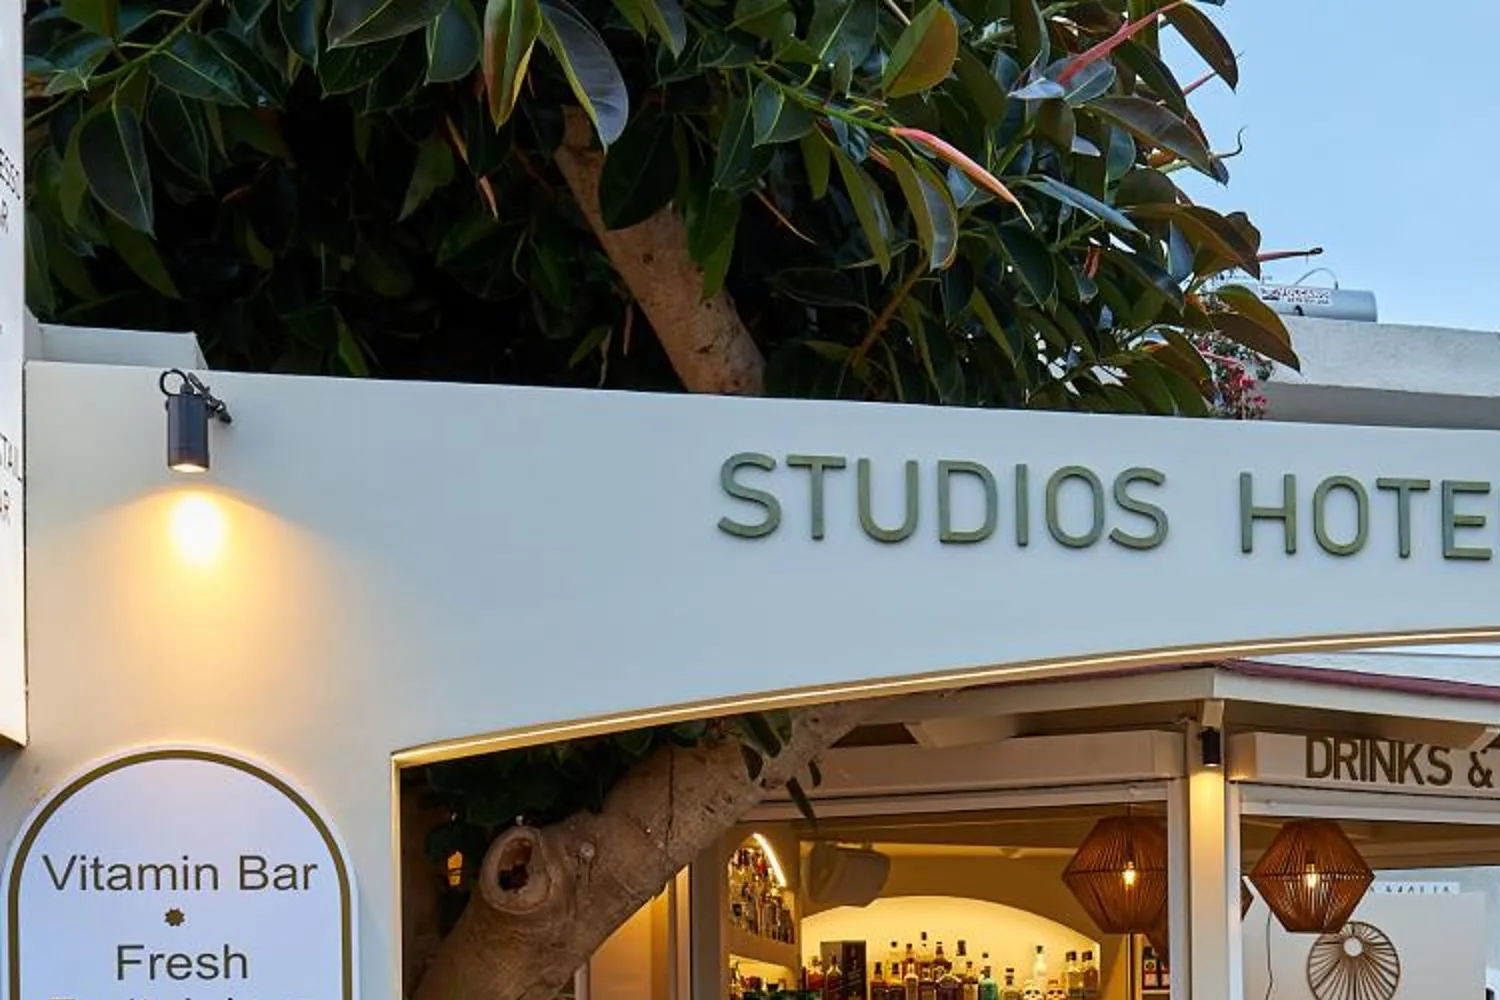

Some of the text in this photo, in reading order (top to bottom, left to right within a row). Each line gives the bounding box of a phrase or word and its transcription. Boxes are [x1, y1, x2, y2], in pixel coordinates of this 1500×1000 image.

[717, 451, 1169, 551] STUDIOS
[1305, 735, 1453, 787] DRINKS
[1467, 748, 1495, 789] &
[42, 854, 319, 892] Vitamin Bar
[116, 943, 249, 981] Fresh
